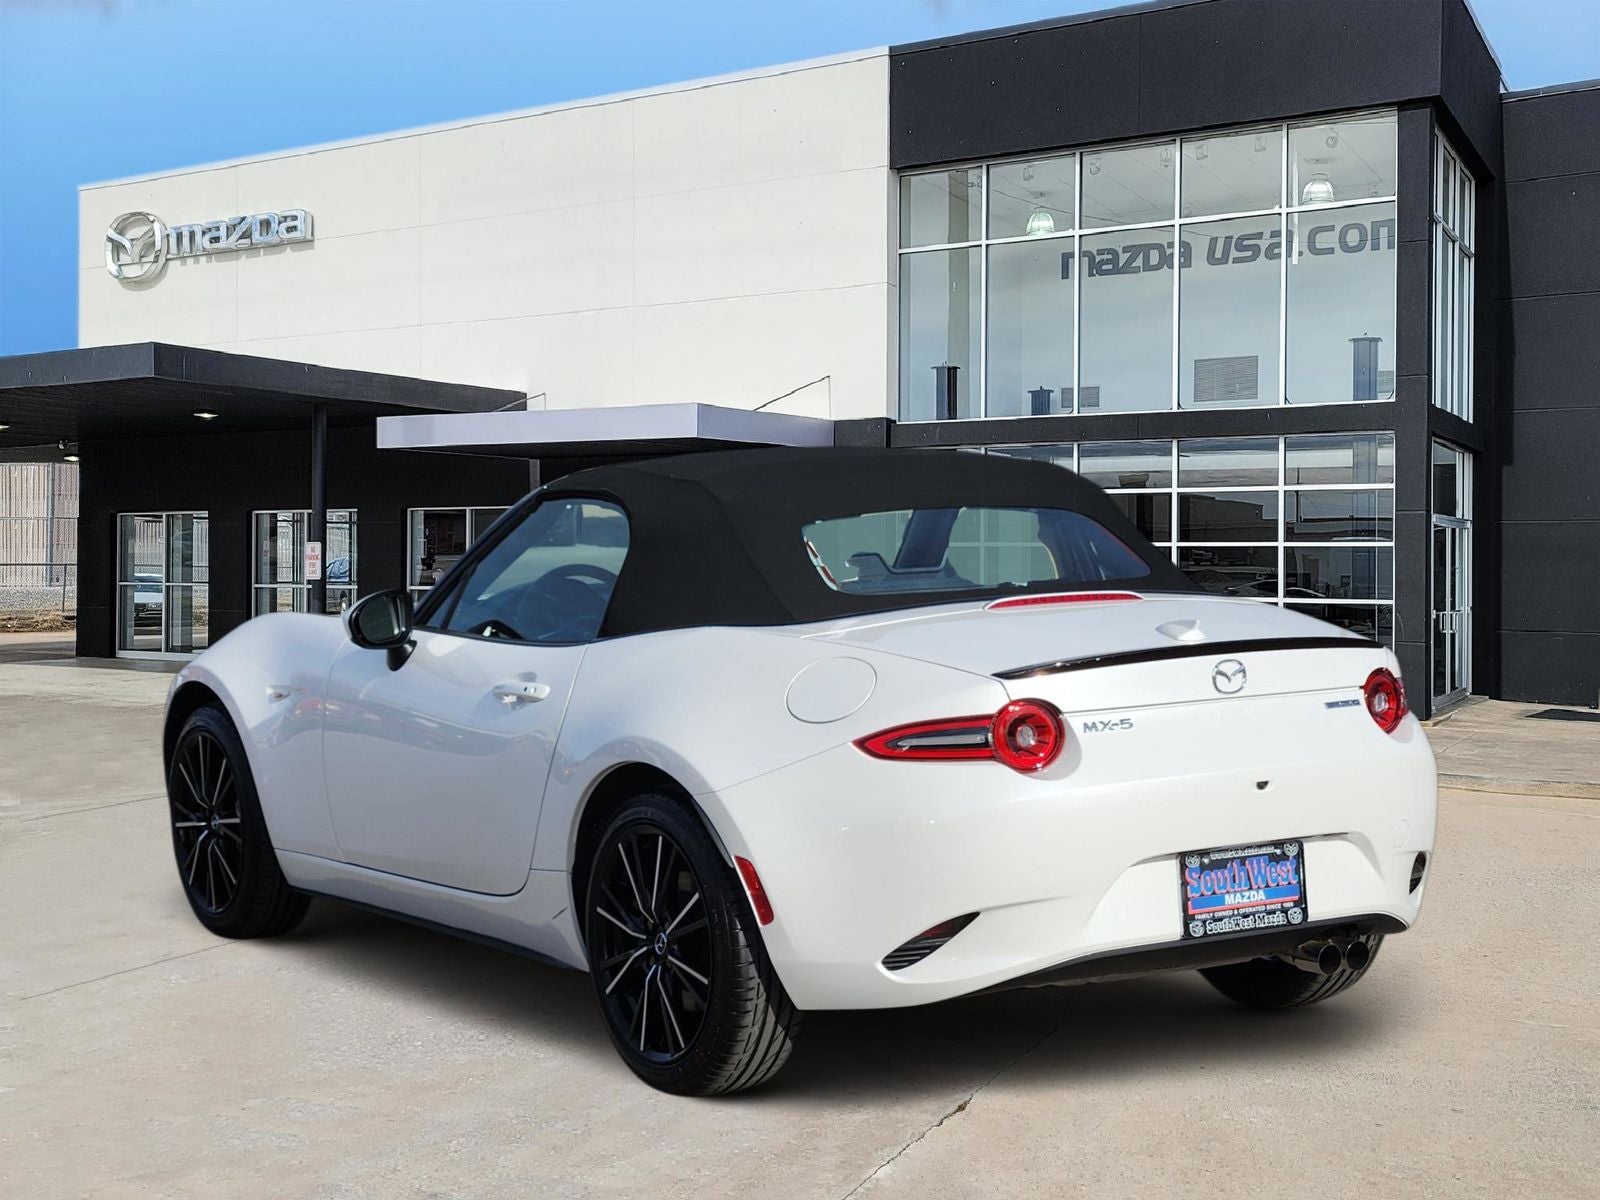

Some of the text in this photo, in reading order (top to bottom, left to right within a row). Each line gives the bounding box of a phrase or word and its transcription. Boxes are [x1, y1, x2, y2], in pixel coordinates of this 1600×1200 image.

[1083, 718, 1133, 733] MX-5
[1225, 891, 1265, 904] MAZDA
[1206, 911, 1288, 934] SouthWest Mazda
